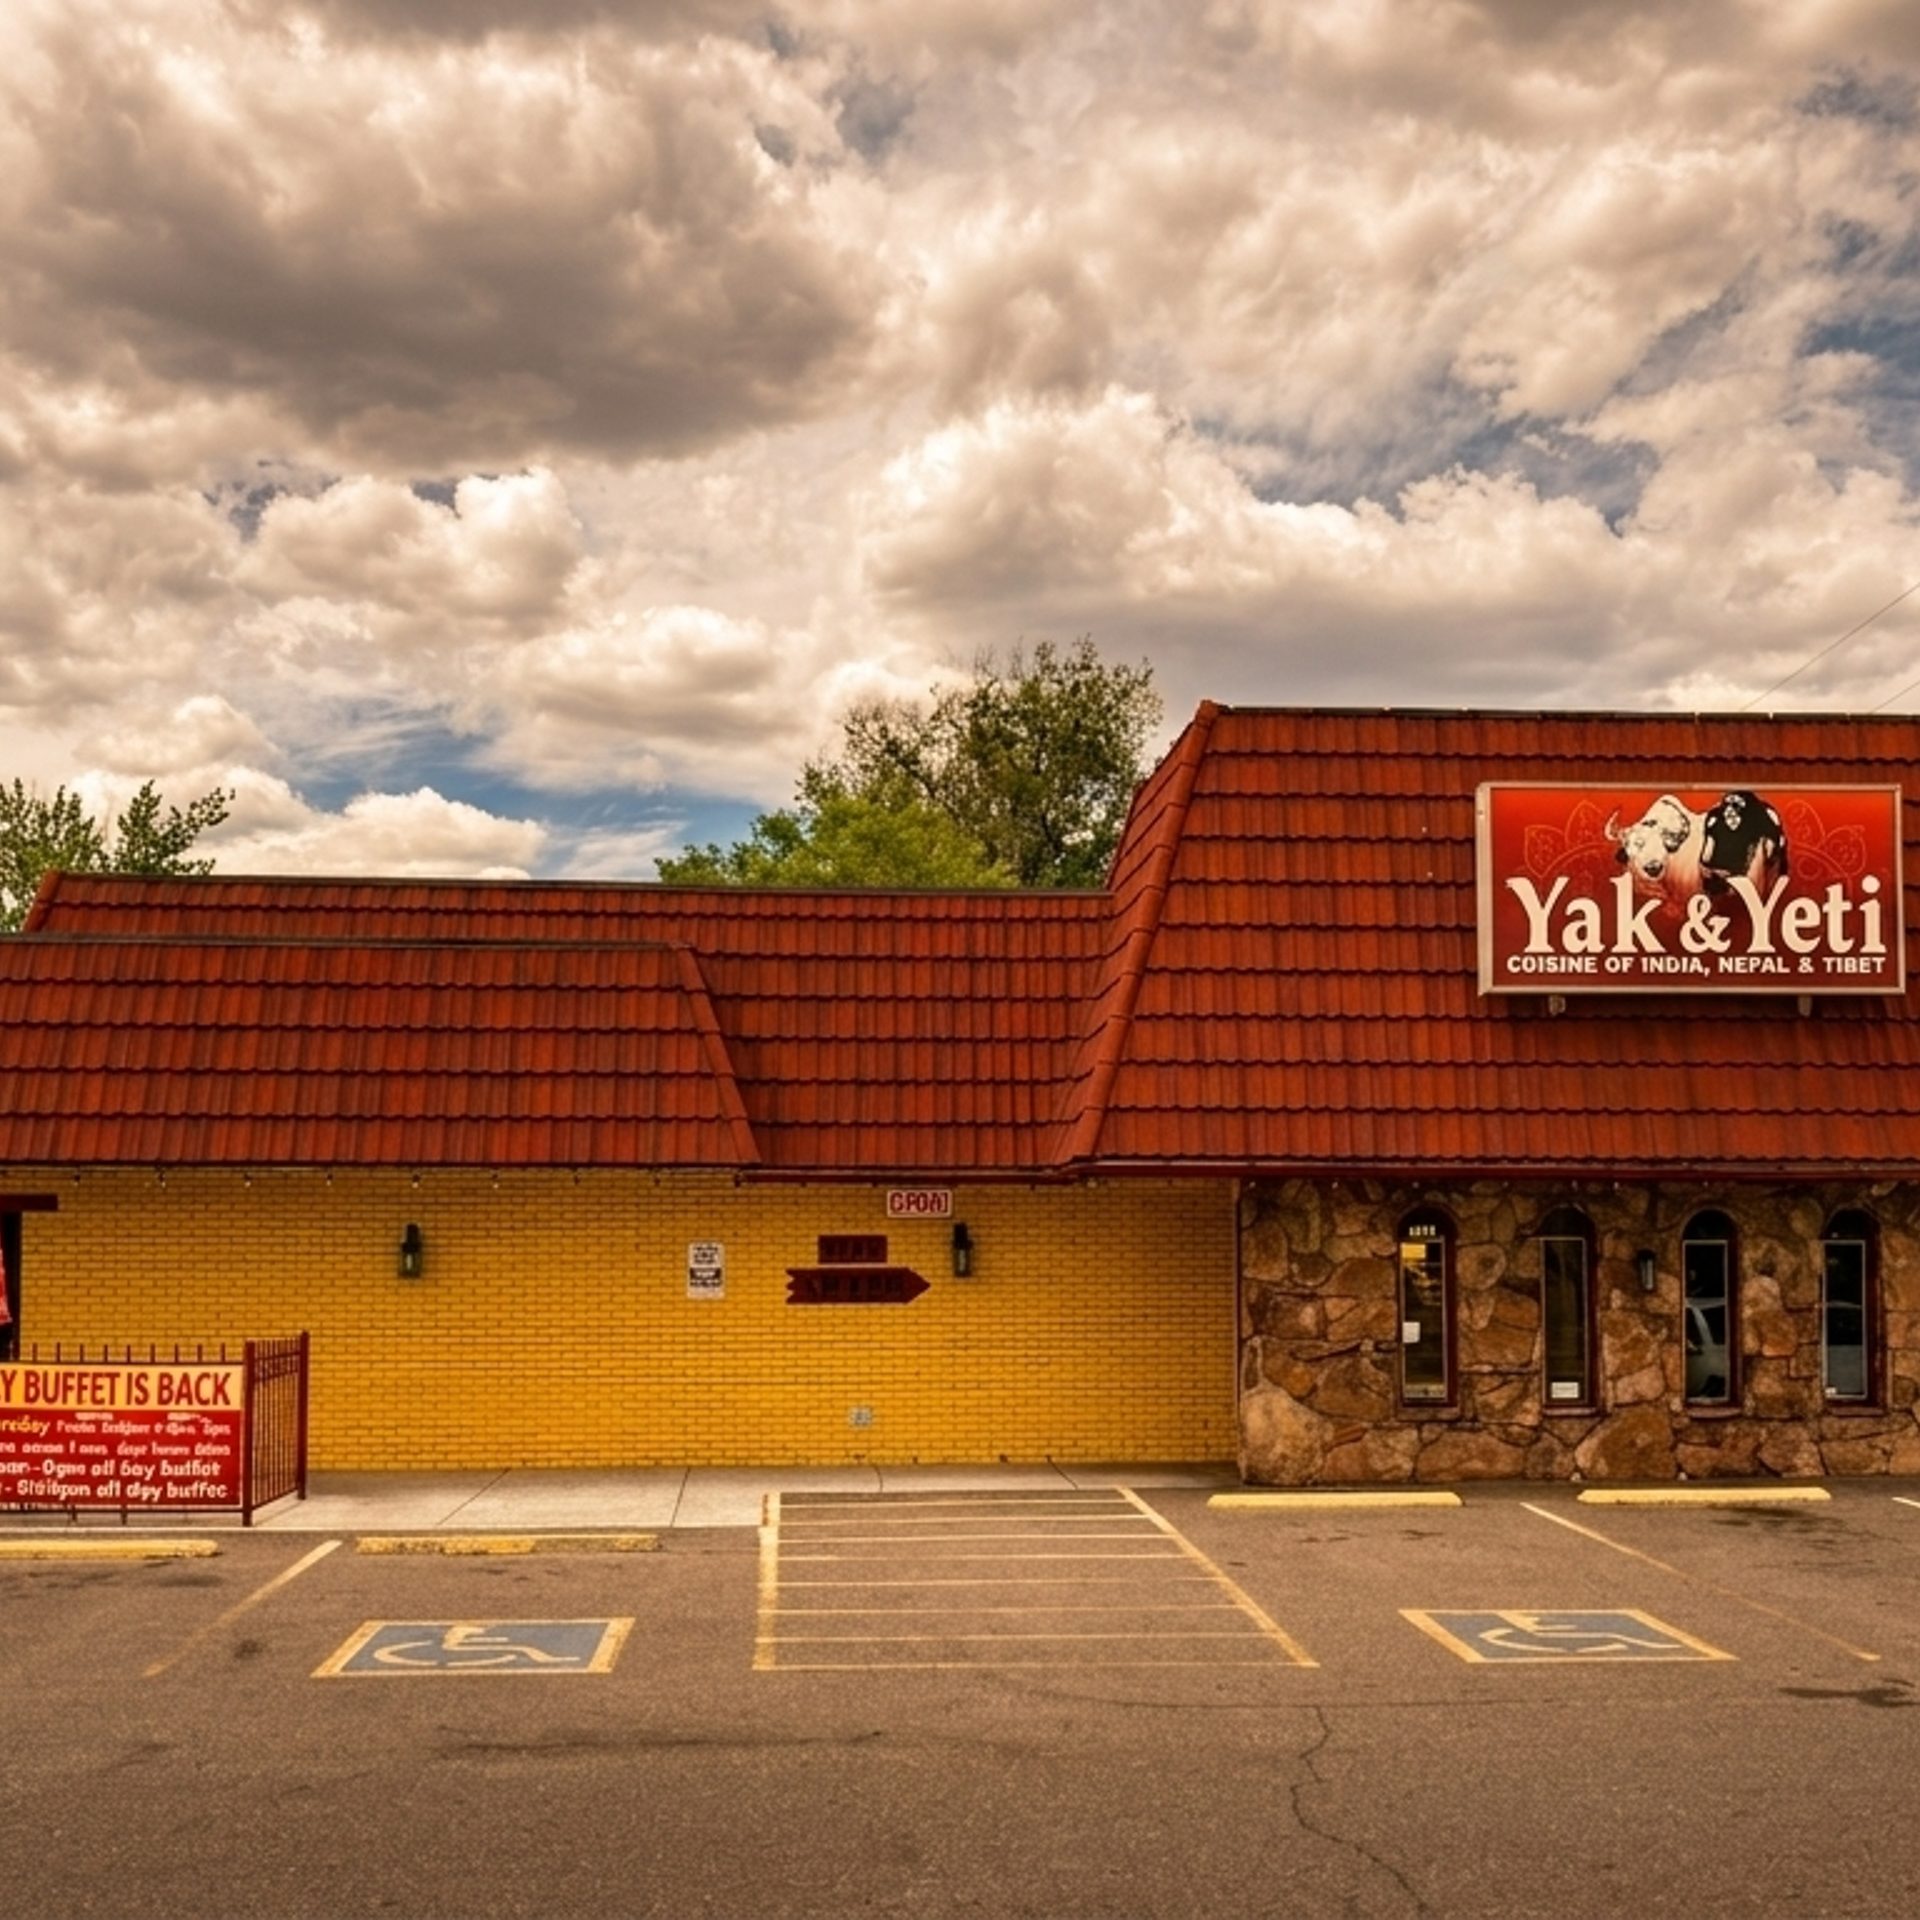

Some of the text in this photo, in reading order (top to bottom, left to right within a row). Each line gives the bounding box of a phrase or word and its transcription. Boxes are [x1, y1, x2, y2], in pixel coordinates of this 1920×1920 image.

[1506, 872, 1887, 954] Yak & Yeti
[1604, 956, 1634, 974] OF
[1641, 956, 1711, 977] INDIA,
[1718, 956, 1791, 974] NEPAL
[1797, 956, 1815, 974] &
[1822, 956, 1886, 974] TIBET
[24, 1370, 120, 1405] BUFFET
[126, 1372, 150, 1405] IS
[157, 1372, 231, 1406] BACK
